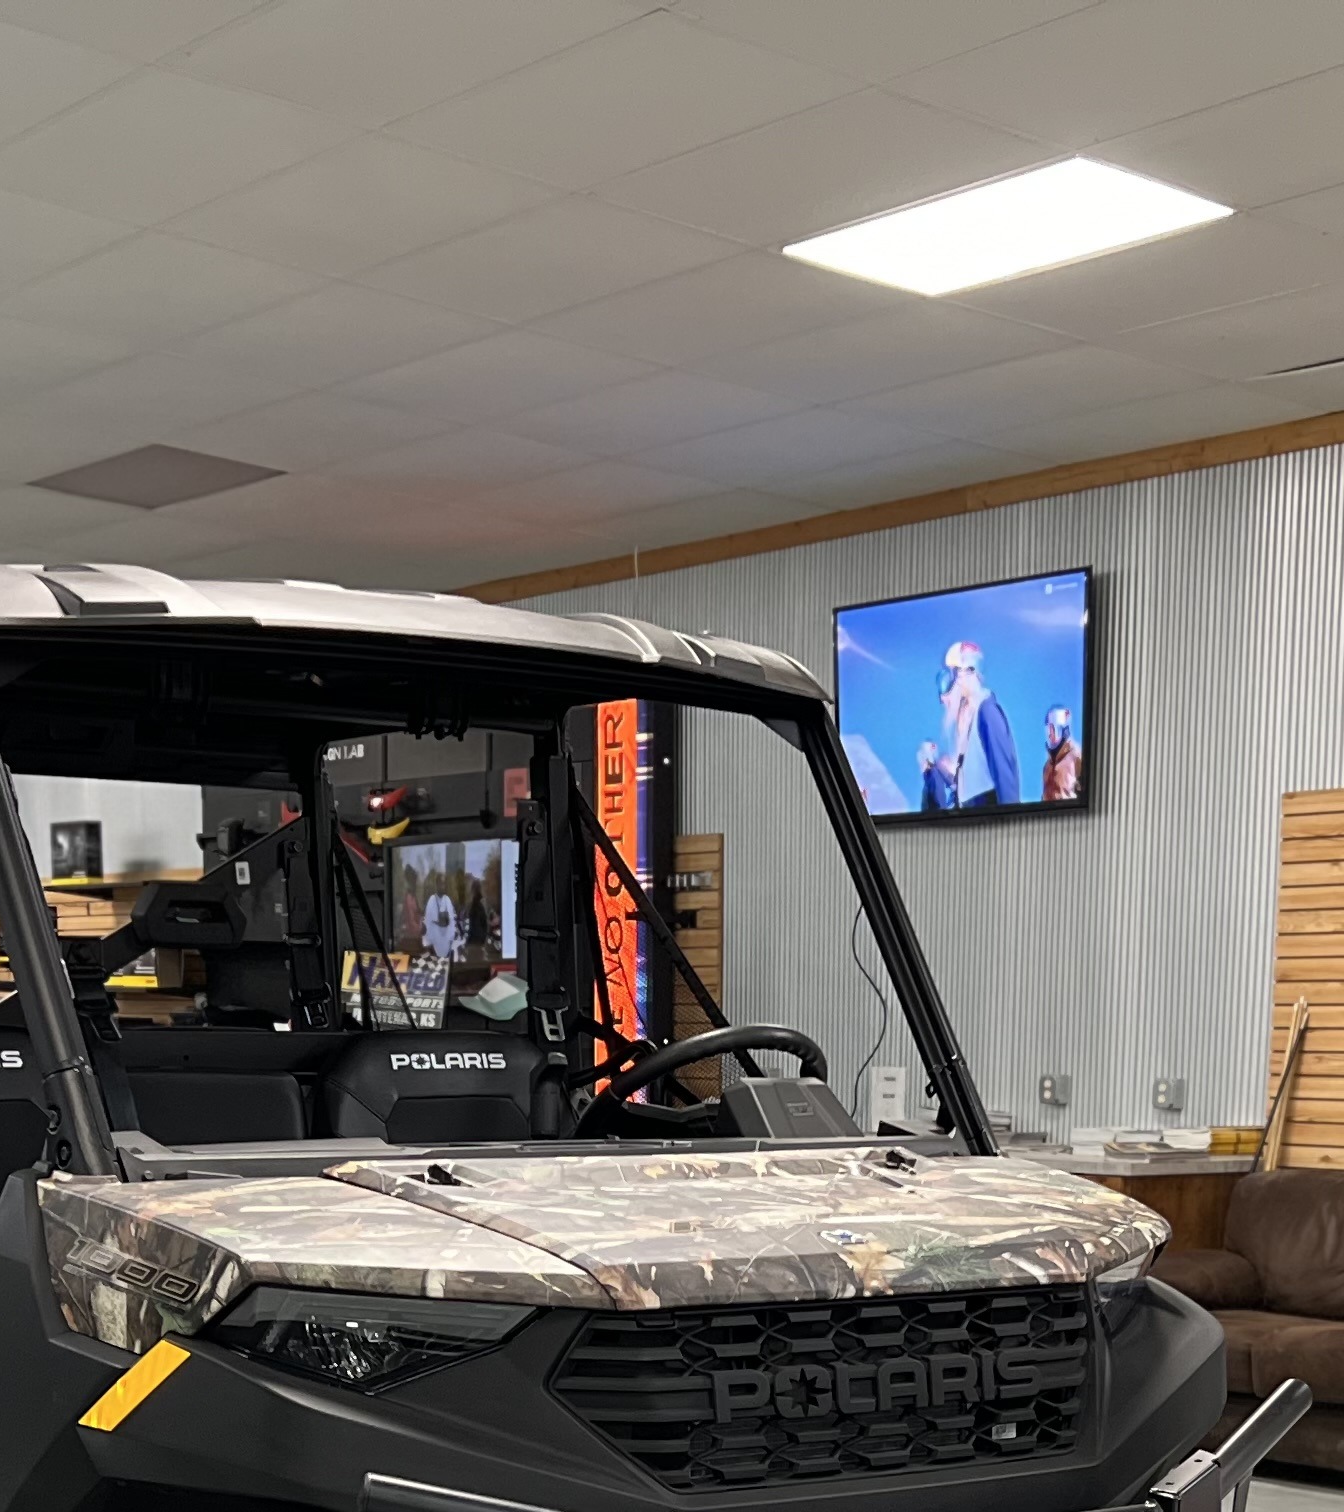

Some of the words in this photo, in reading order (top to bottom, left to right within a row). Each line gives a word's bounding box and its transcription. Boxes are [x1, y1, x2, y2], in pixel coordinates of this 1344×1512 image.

[390, 1053, 507, 1070] POLARIS
[66, 1236, 200, 1303] 1000
[713, 1350, 1042, 1424] POLARIS
